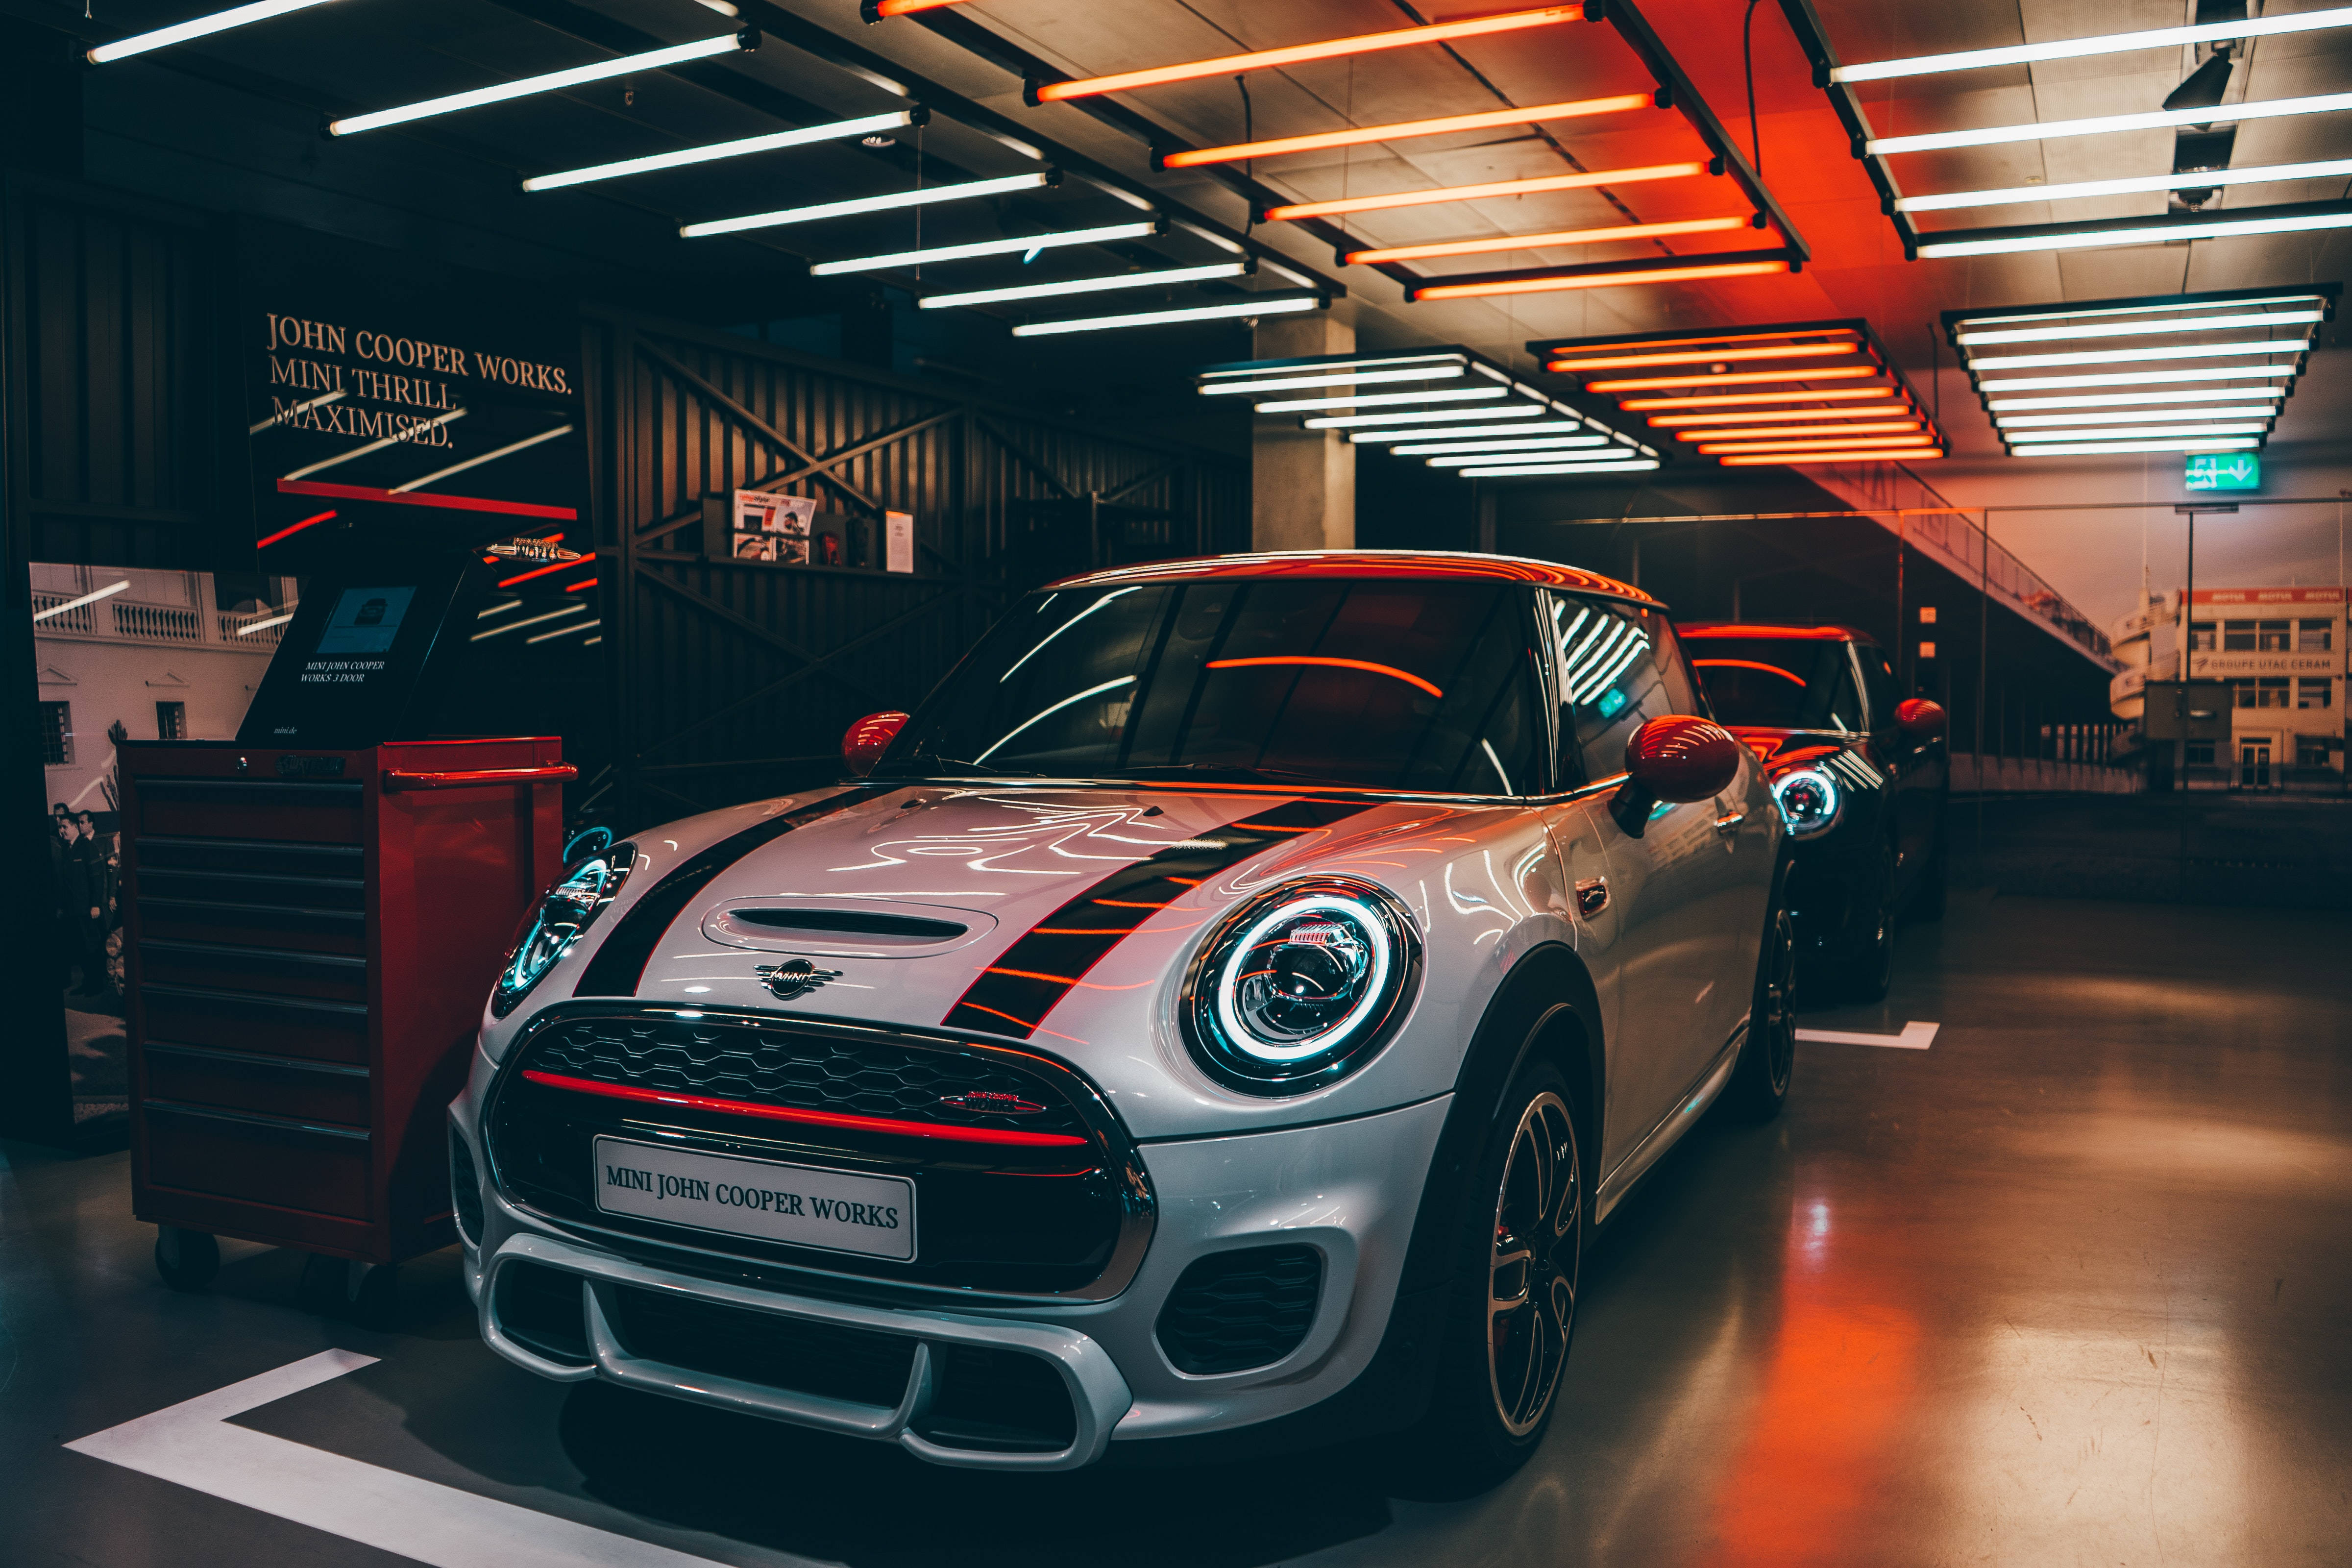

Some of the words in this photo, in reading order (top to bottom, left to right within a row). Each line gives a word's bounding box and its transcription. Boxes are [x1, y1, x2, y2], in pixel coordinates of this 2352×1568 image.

[267, 313, 346, 354] JOHN
[356, 330, 469, 376] COOPER
[474, 352, 572, 394] WORKS.
[269, 355, 343, 393] MINI
[352, 368, 456, 410] THRILL
[271, 396, 453, 449] MAXIMISED.
[301, 674, 332, 682] WORKS
[333, 674, 339, 682] 3
[340, 674, 365, 682] DOOR
[306, 662, 327, 670] MINI
[325, 662, 349, 672] JOHN
[350, 662, 385, 670] COOPER
[2211, 660, 2254, 669] GROUPE
[606, 1165, 653, 1193] MINI
[656, 1174, 710, 1201] JOHN
[715, 1184, 805, 1216] COOPER
[809, 1197, 899, 1229] WORKS
